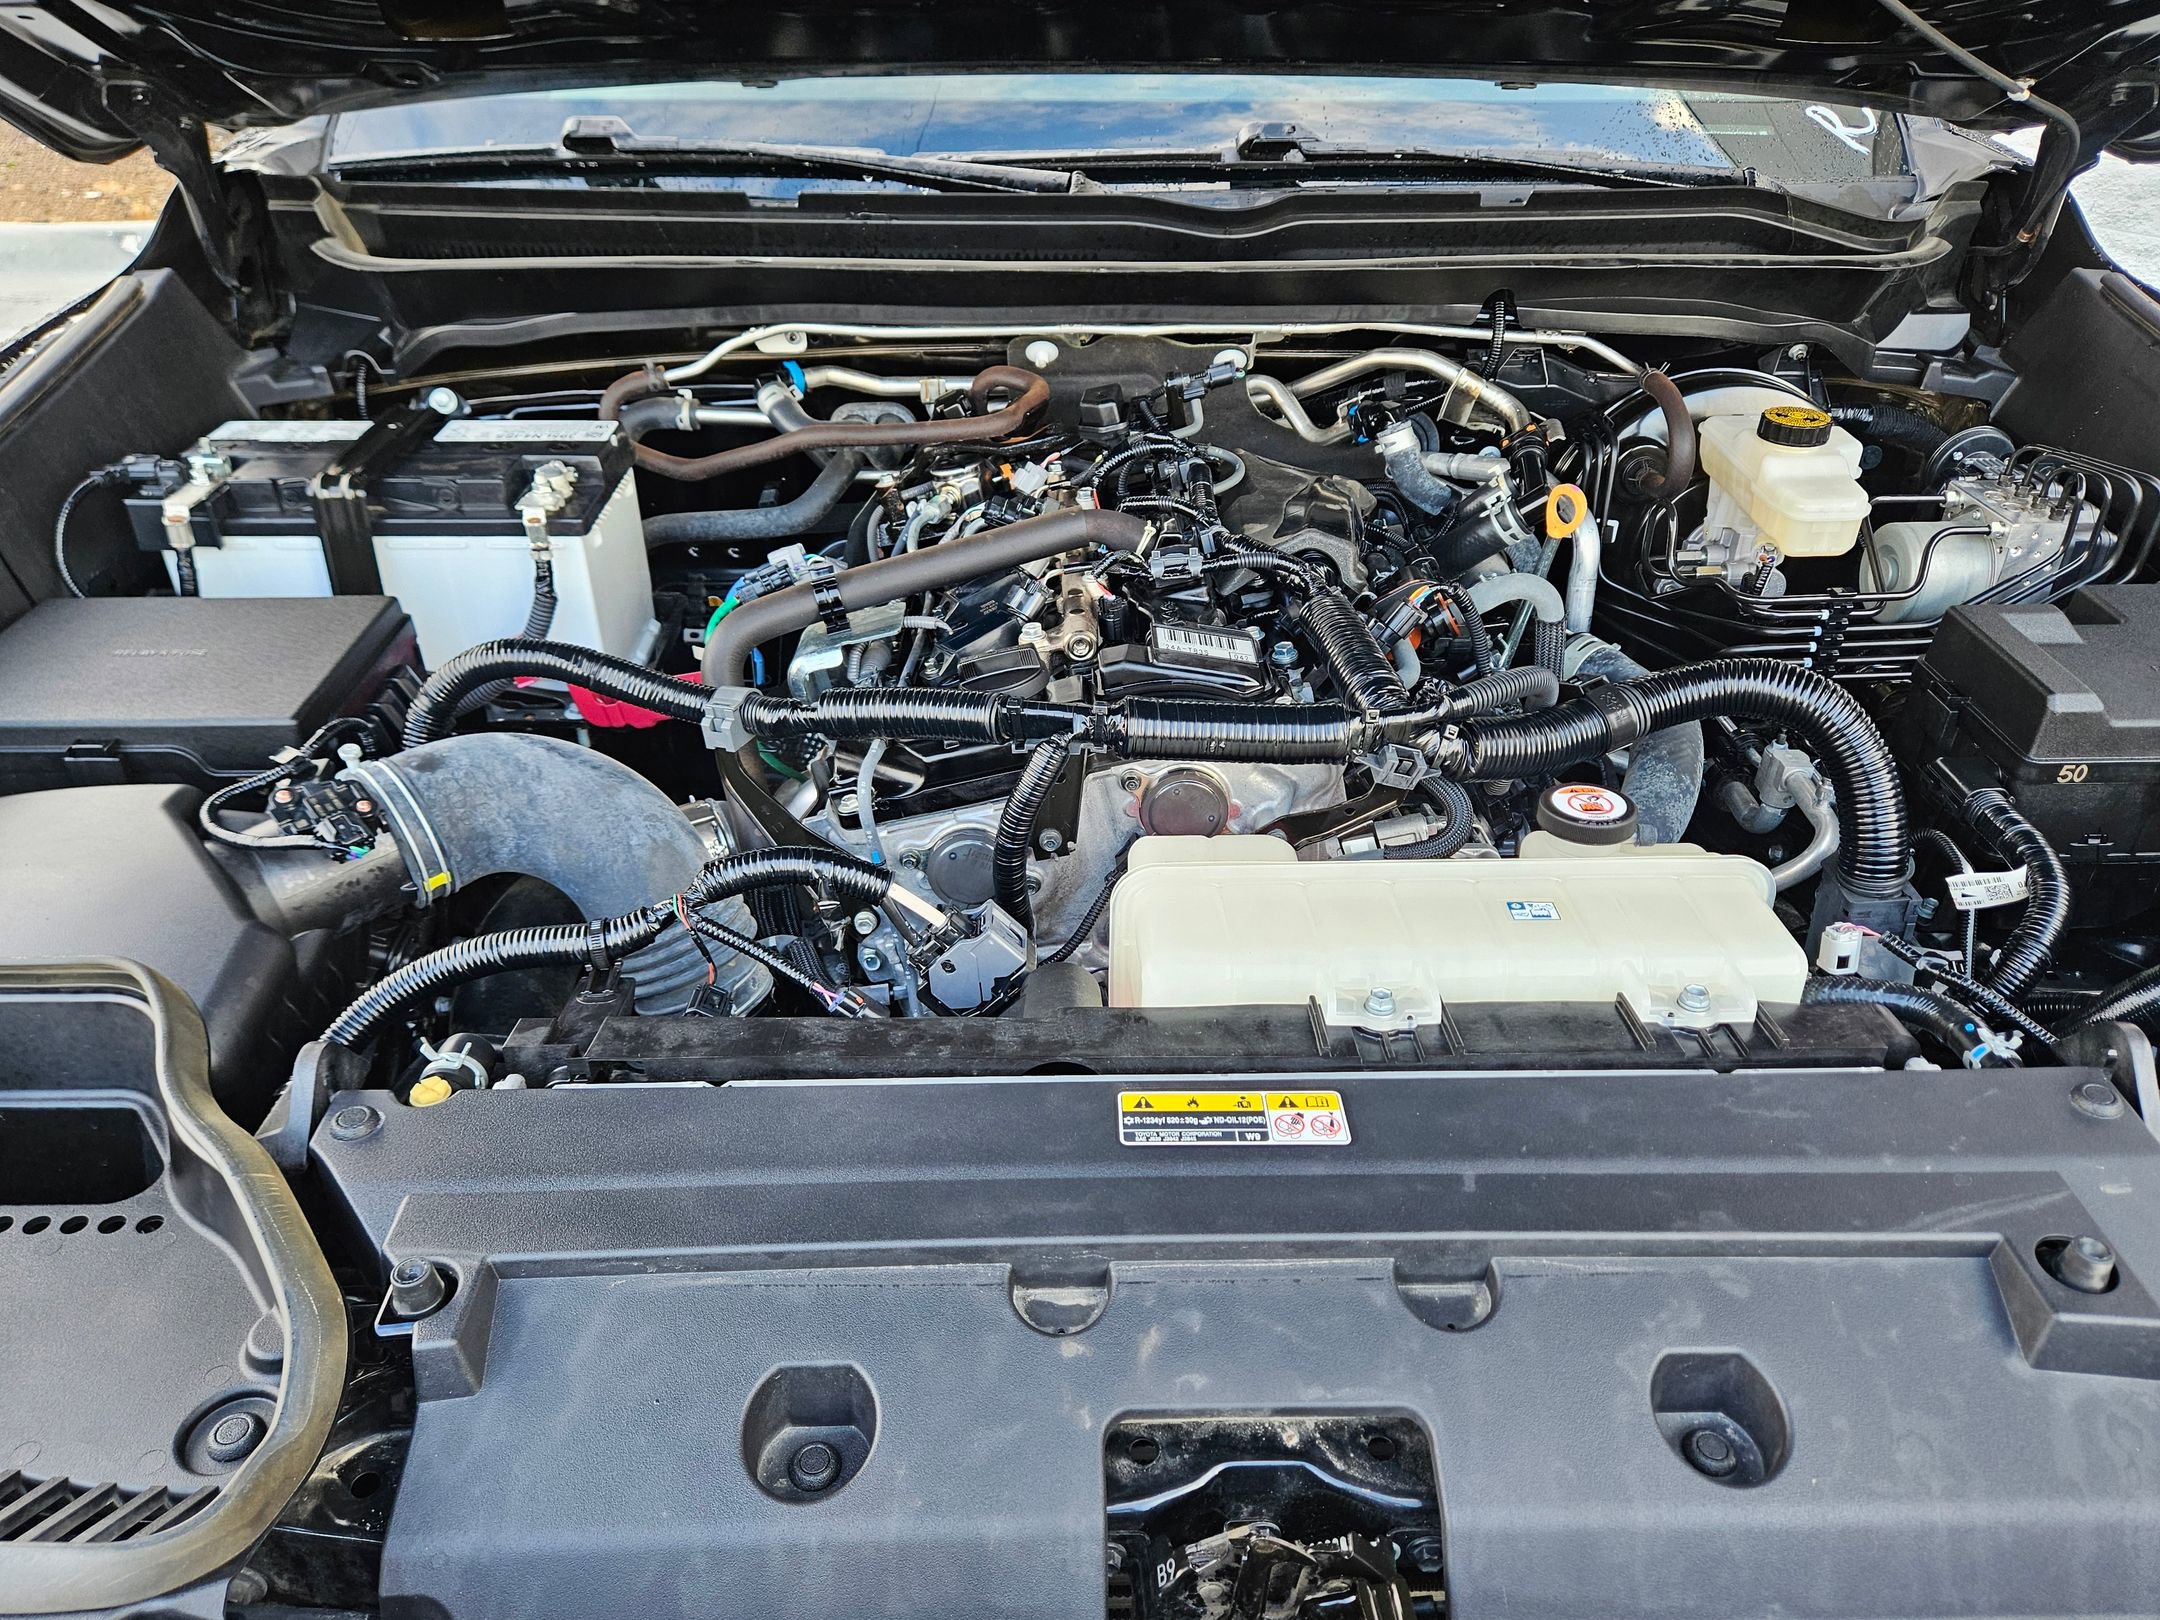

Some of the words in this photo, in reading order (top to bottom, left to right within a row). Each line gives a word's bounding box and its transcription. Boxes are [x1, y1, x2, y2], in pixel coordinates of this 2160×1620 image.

[2056, 763, 2089, 783] 50
[1245, 1132, 1261, 1141] W9
[1157, 1557, 1176, 1588] B9
